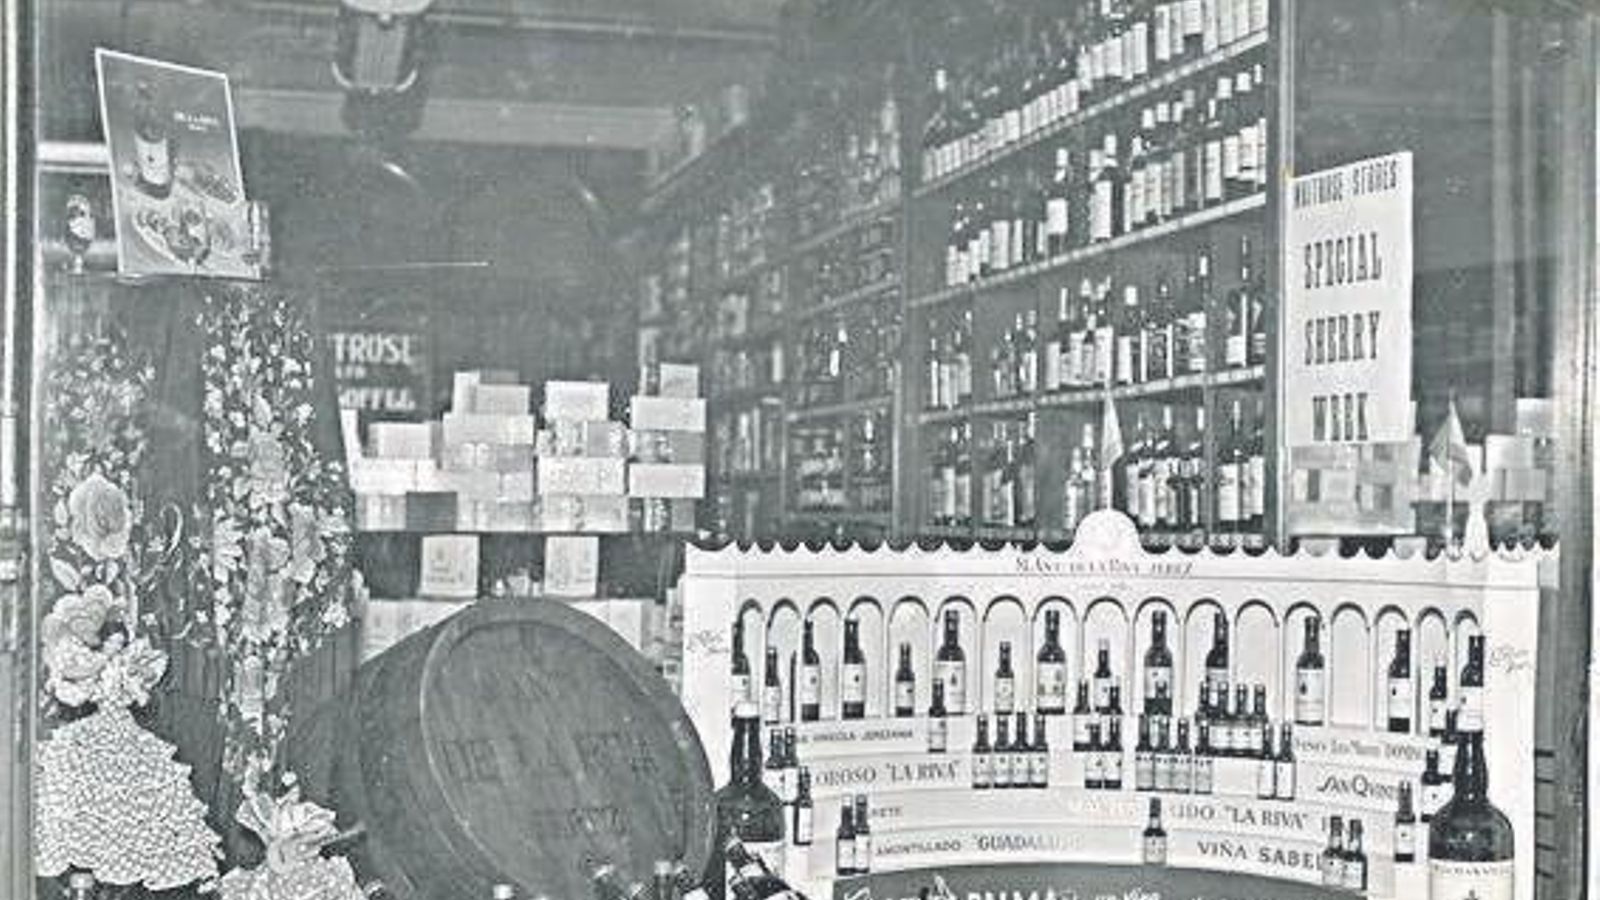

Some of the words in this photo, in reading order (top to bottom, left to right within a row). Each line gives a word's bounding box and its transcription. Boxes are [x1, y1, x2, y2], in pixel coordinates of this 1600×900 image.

[1352, 159, 1398, 195] STORES
[1304, 231, 1382, 289] SPECIAL
[1304, 310, 1380, 366] SHERRY
[1312, 392, 1368, 442] WEEK
[1197, 839, 1248, 860] VIÑA
